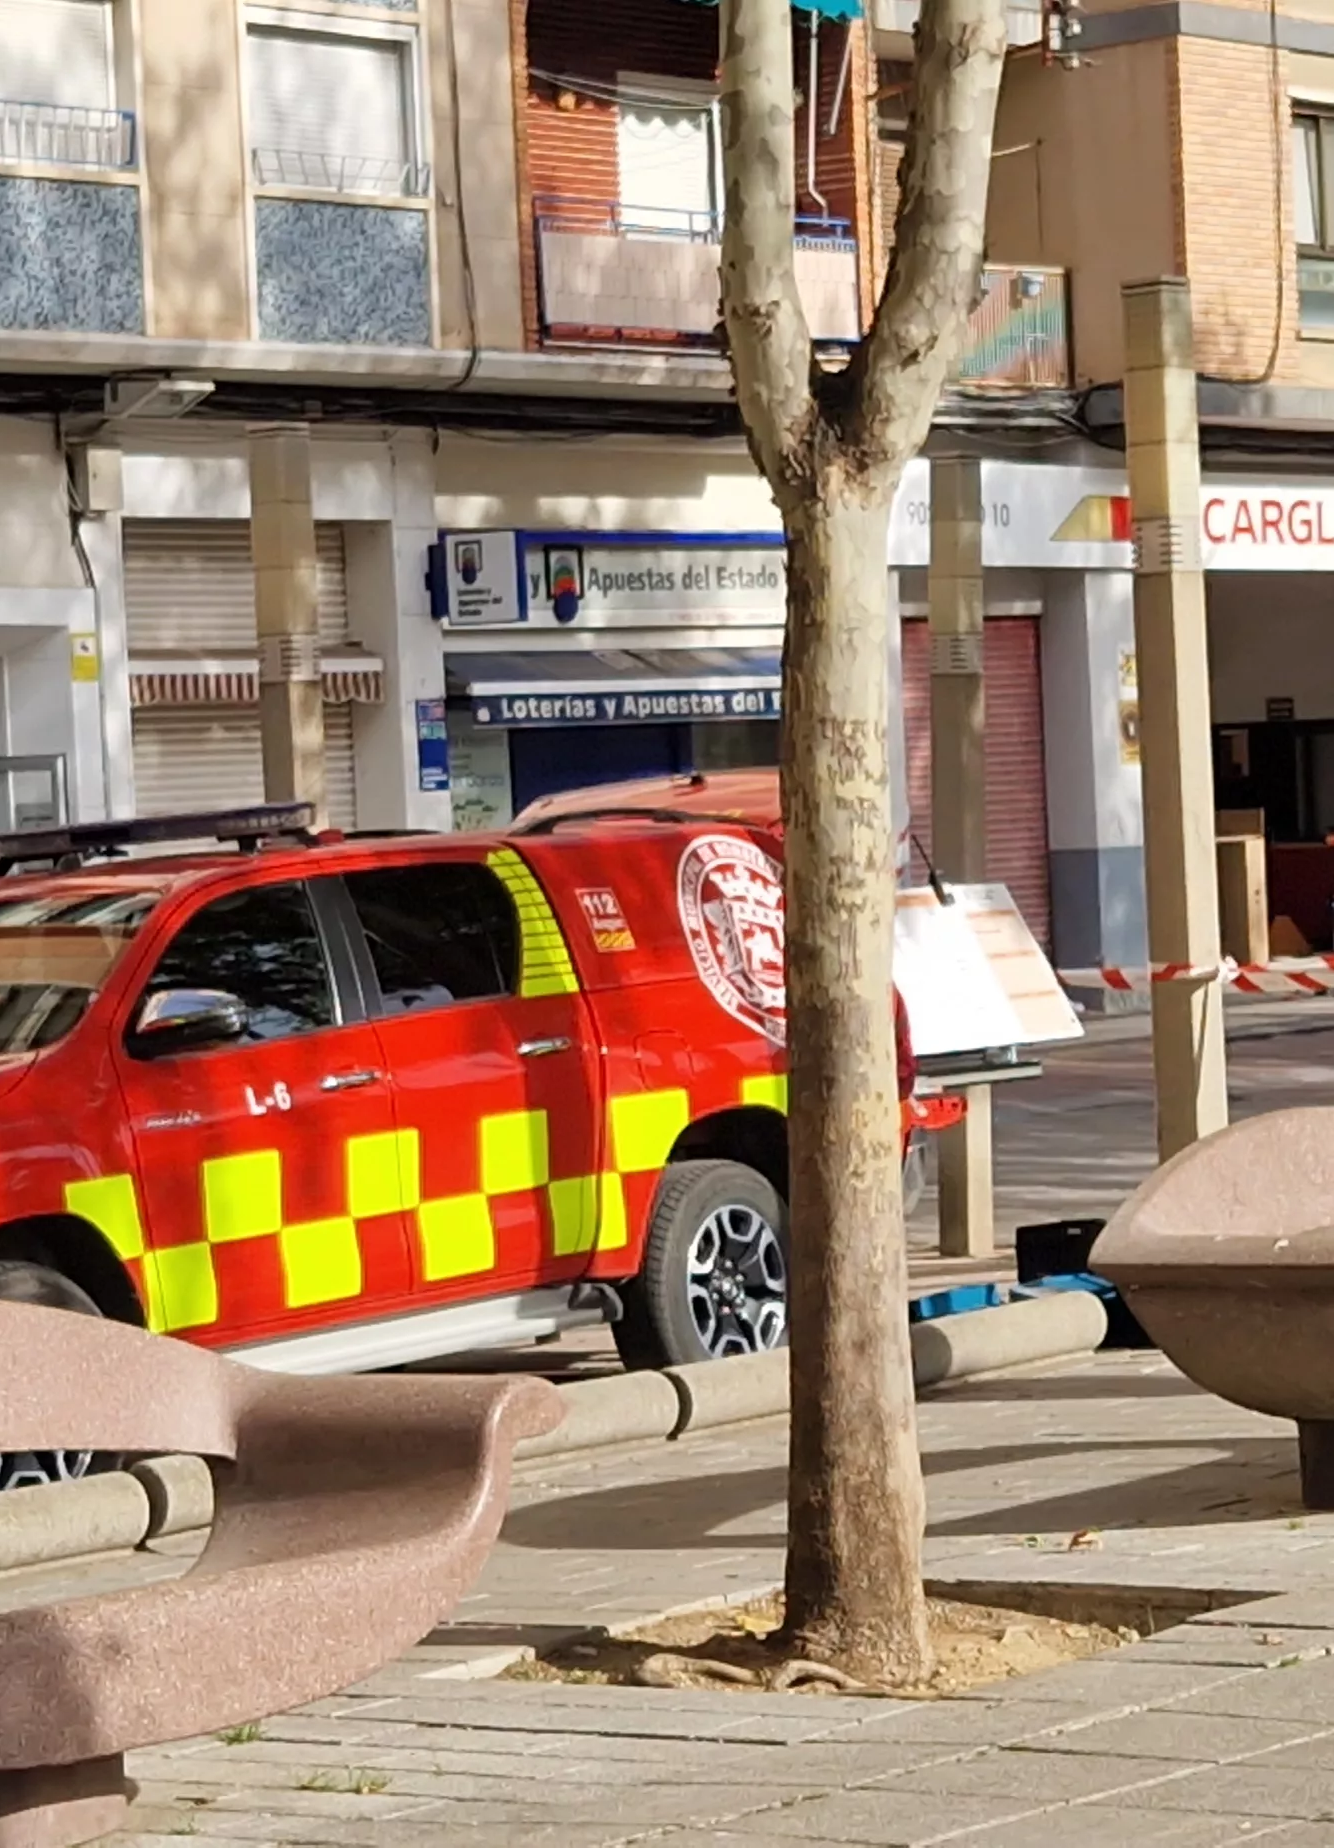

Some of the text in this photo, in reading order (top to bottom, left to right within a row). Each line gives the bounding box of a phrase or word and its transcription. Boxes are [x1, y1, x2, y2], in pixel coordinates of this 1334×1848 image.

[907, 501, 931, 526] 90
[530, 565, 779, 599] y Apuestas del Estado
[501, 695, 596, 719] Loterías
[605, 699, 617, 720] y
[622, 695, 725, 718] Apuestas
[732, 691, 765, 713] del
[581, 893, 618, 916] 112
[245, 1080, 292, 1116] L-6
